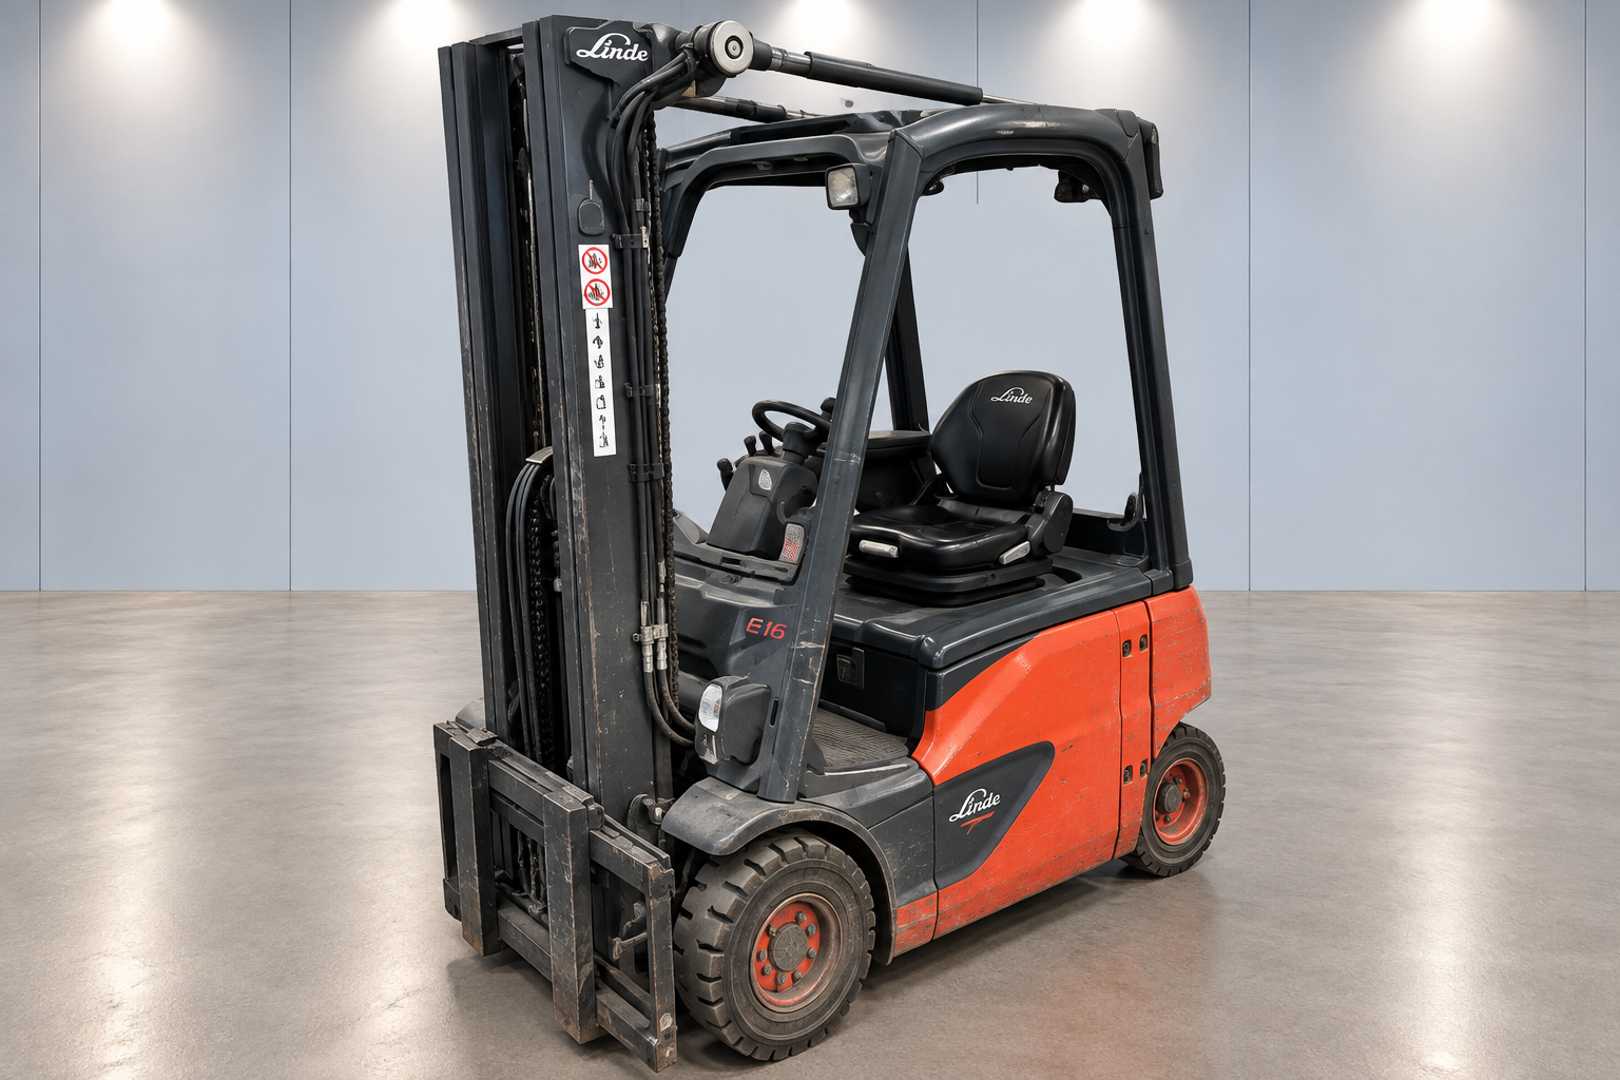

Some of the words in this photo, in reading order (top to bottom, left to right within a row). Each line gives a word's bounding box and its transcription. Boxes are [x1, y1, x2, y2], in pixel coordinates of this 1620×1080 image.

[576, 33, 649, 62] Linde
[990, 387, 1033, 404] Linde
[745, 617, 786, 640] E16
[949, 788, 1001, 822] Linde
